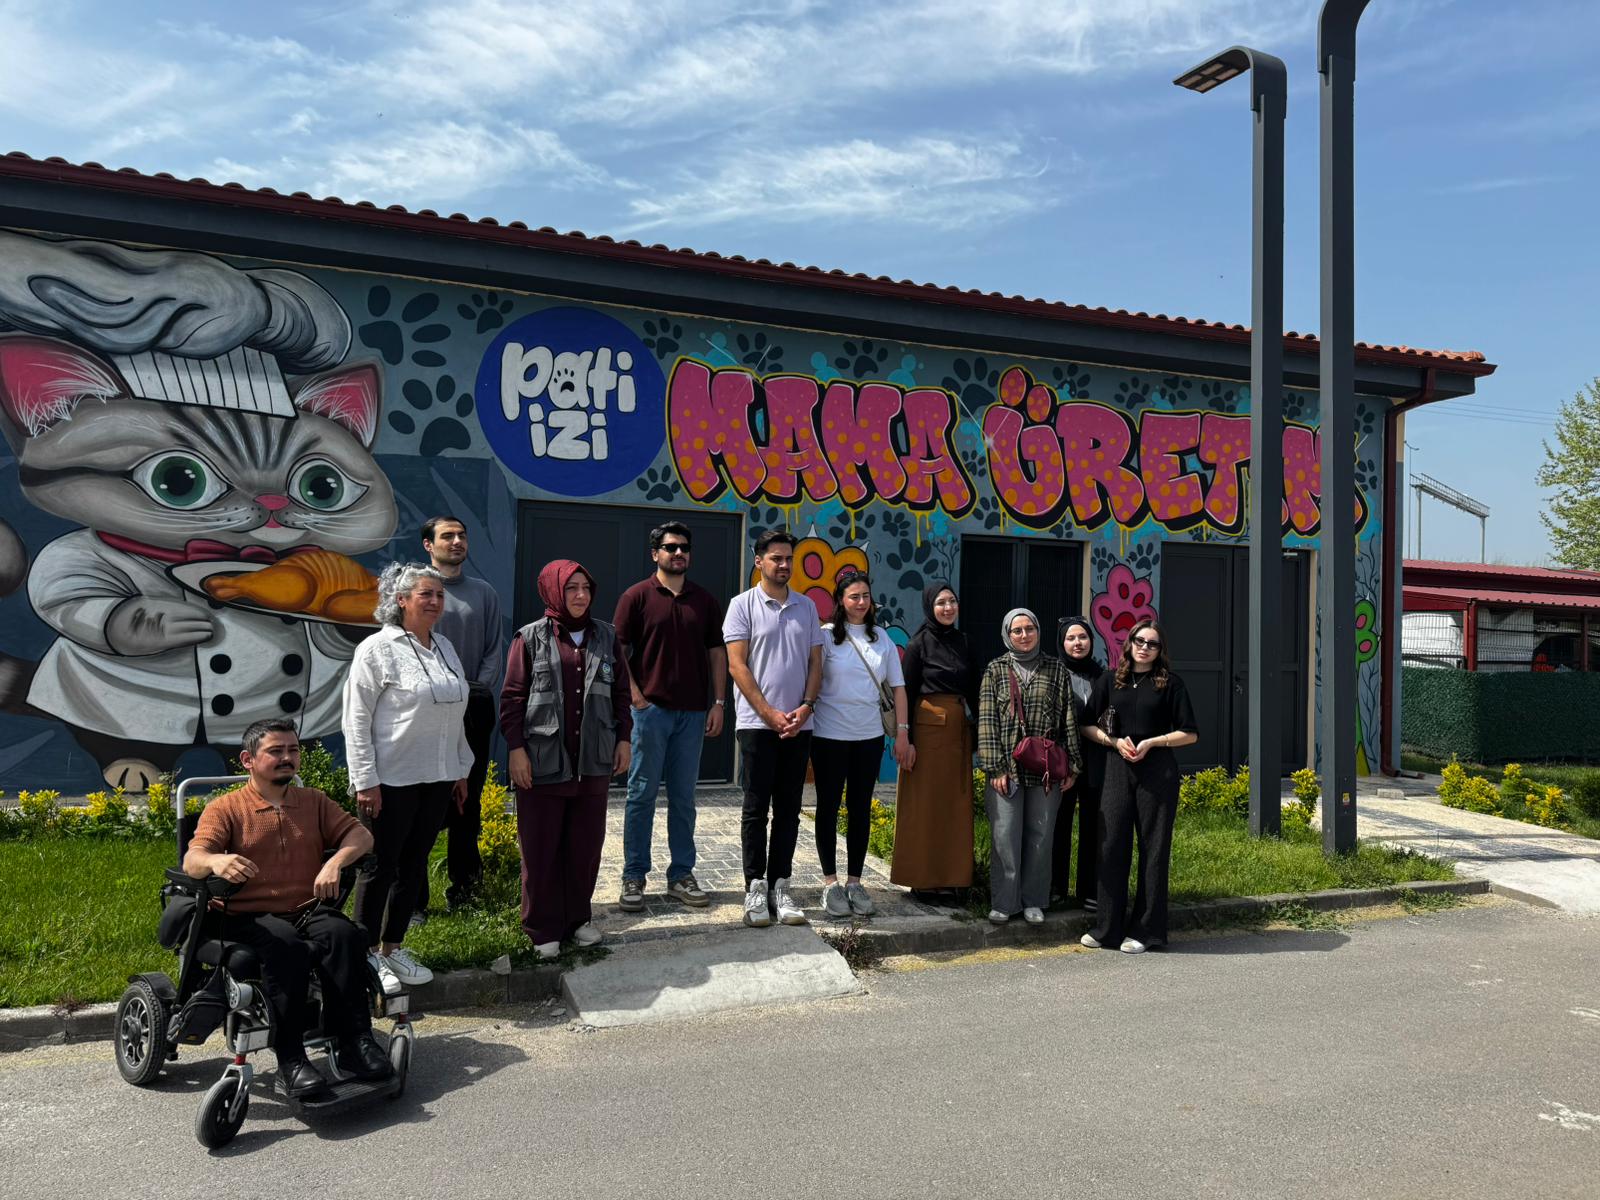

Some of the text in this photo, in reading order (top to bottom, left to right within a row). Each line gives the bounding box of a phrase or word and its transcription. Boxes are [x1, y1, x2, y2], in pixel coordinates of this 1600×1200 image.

[501, 341, 636, 421] pati
[528, 402, 608, 460] izi
[667, 358, 1366, 534] MAMA ÜRETM
